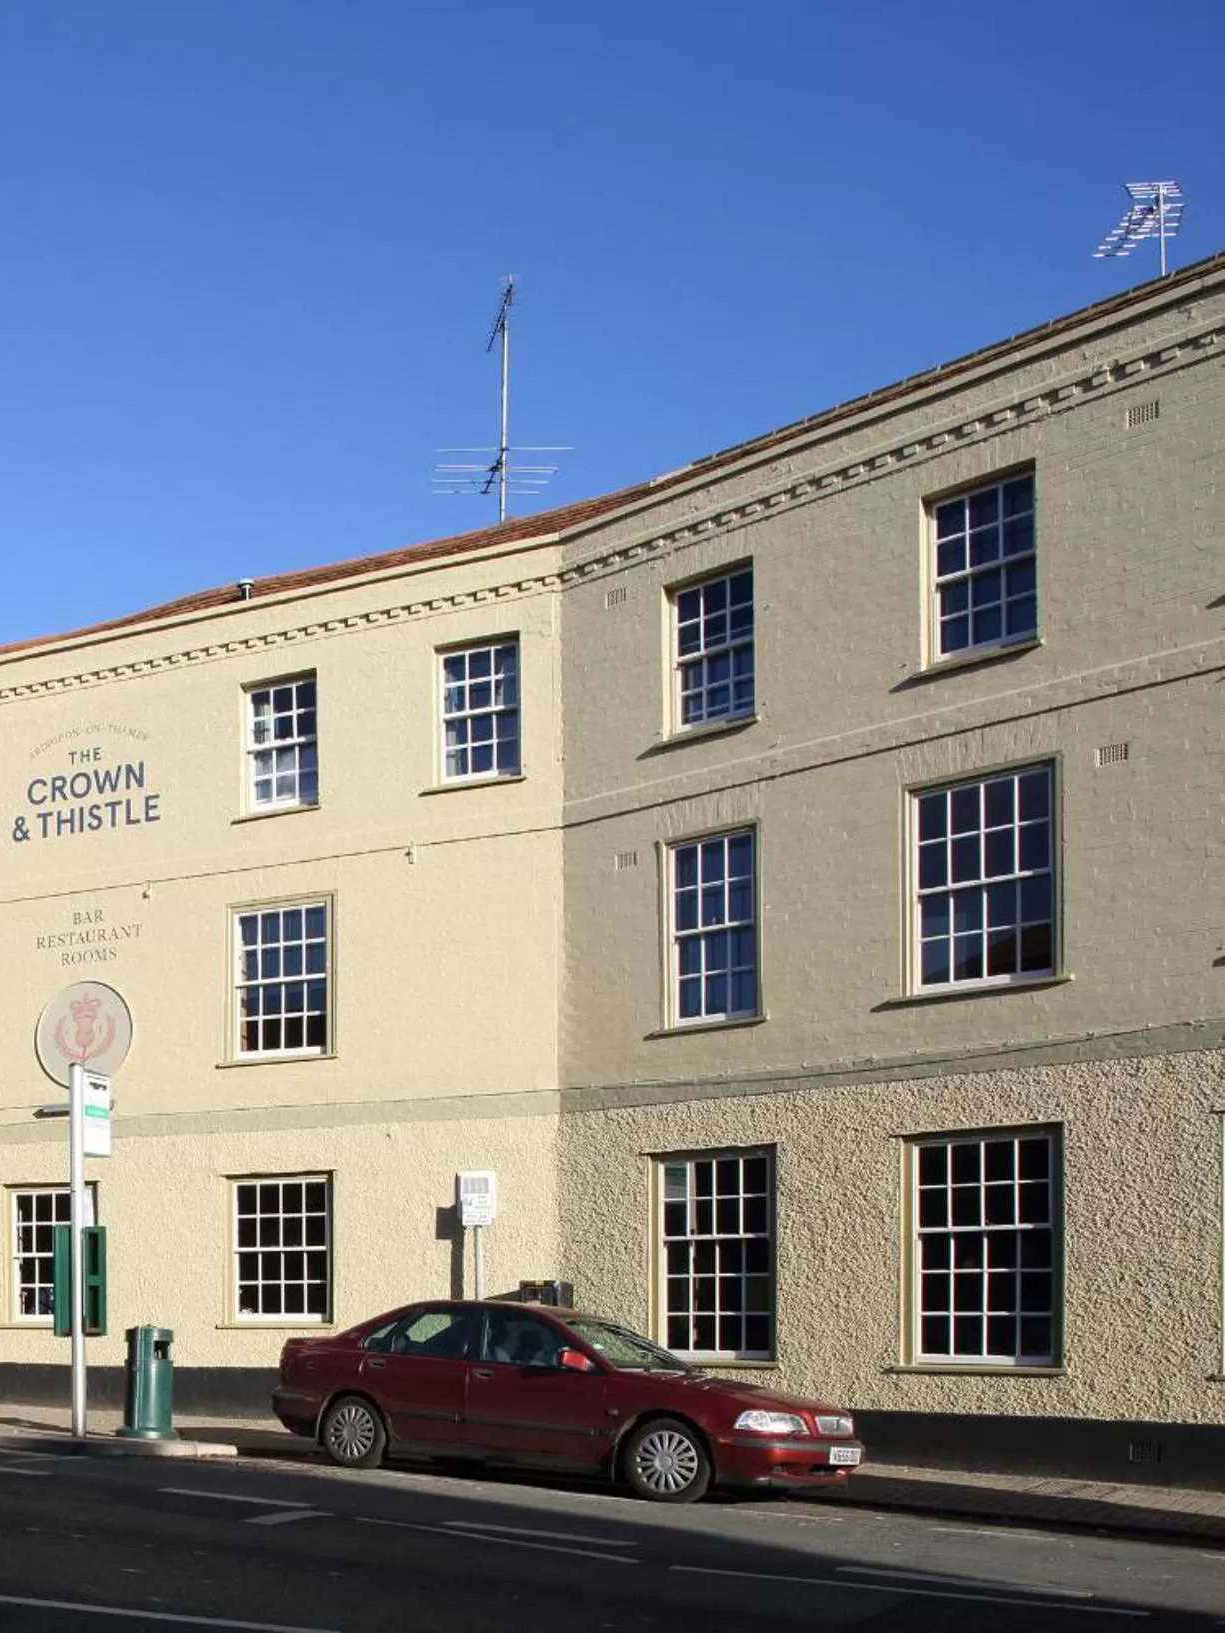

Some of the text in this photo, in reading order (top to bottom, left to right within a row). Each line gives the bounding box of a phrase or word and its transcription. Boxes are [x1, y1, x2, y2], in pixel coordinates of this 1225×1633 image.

[68, 747, 103, 765] THE
[27, 761, 145, 805] CROWN
[12, 794, 161, 843] & THISTLE
[73, 909, 104, 925] BAR
[36, 923, 143, 950] RESTAURANT
[61, 947, 117, 966] ROOMS
